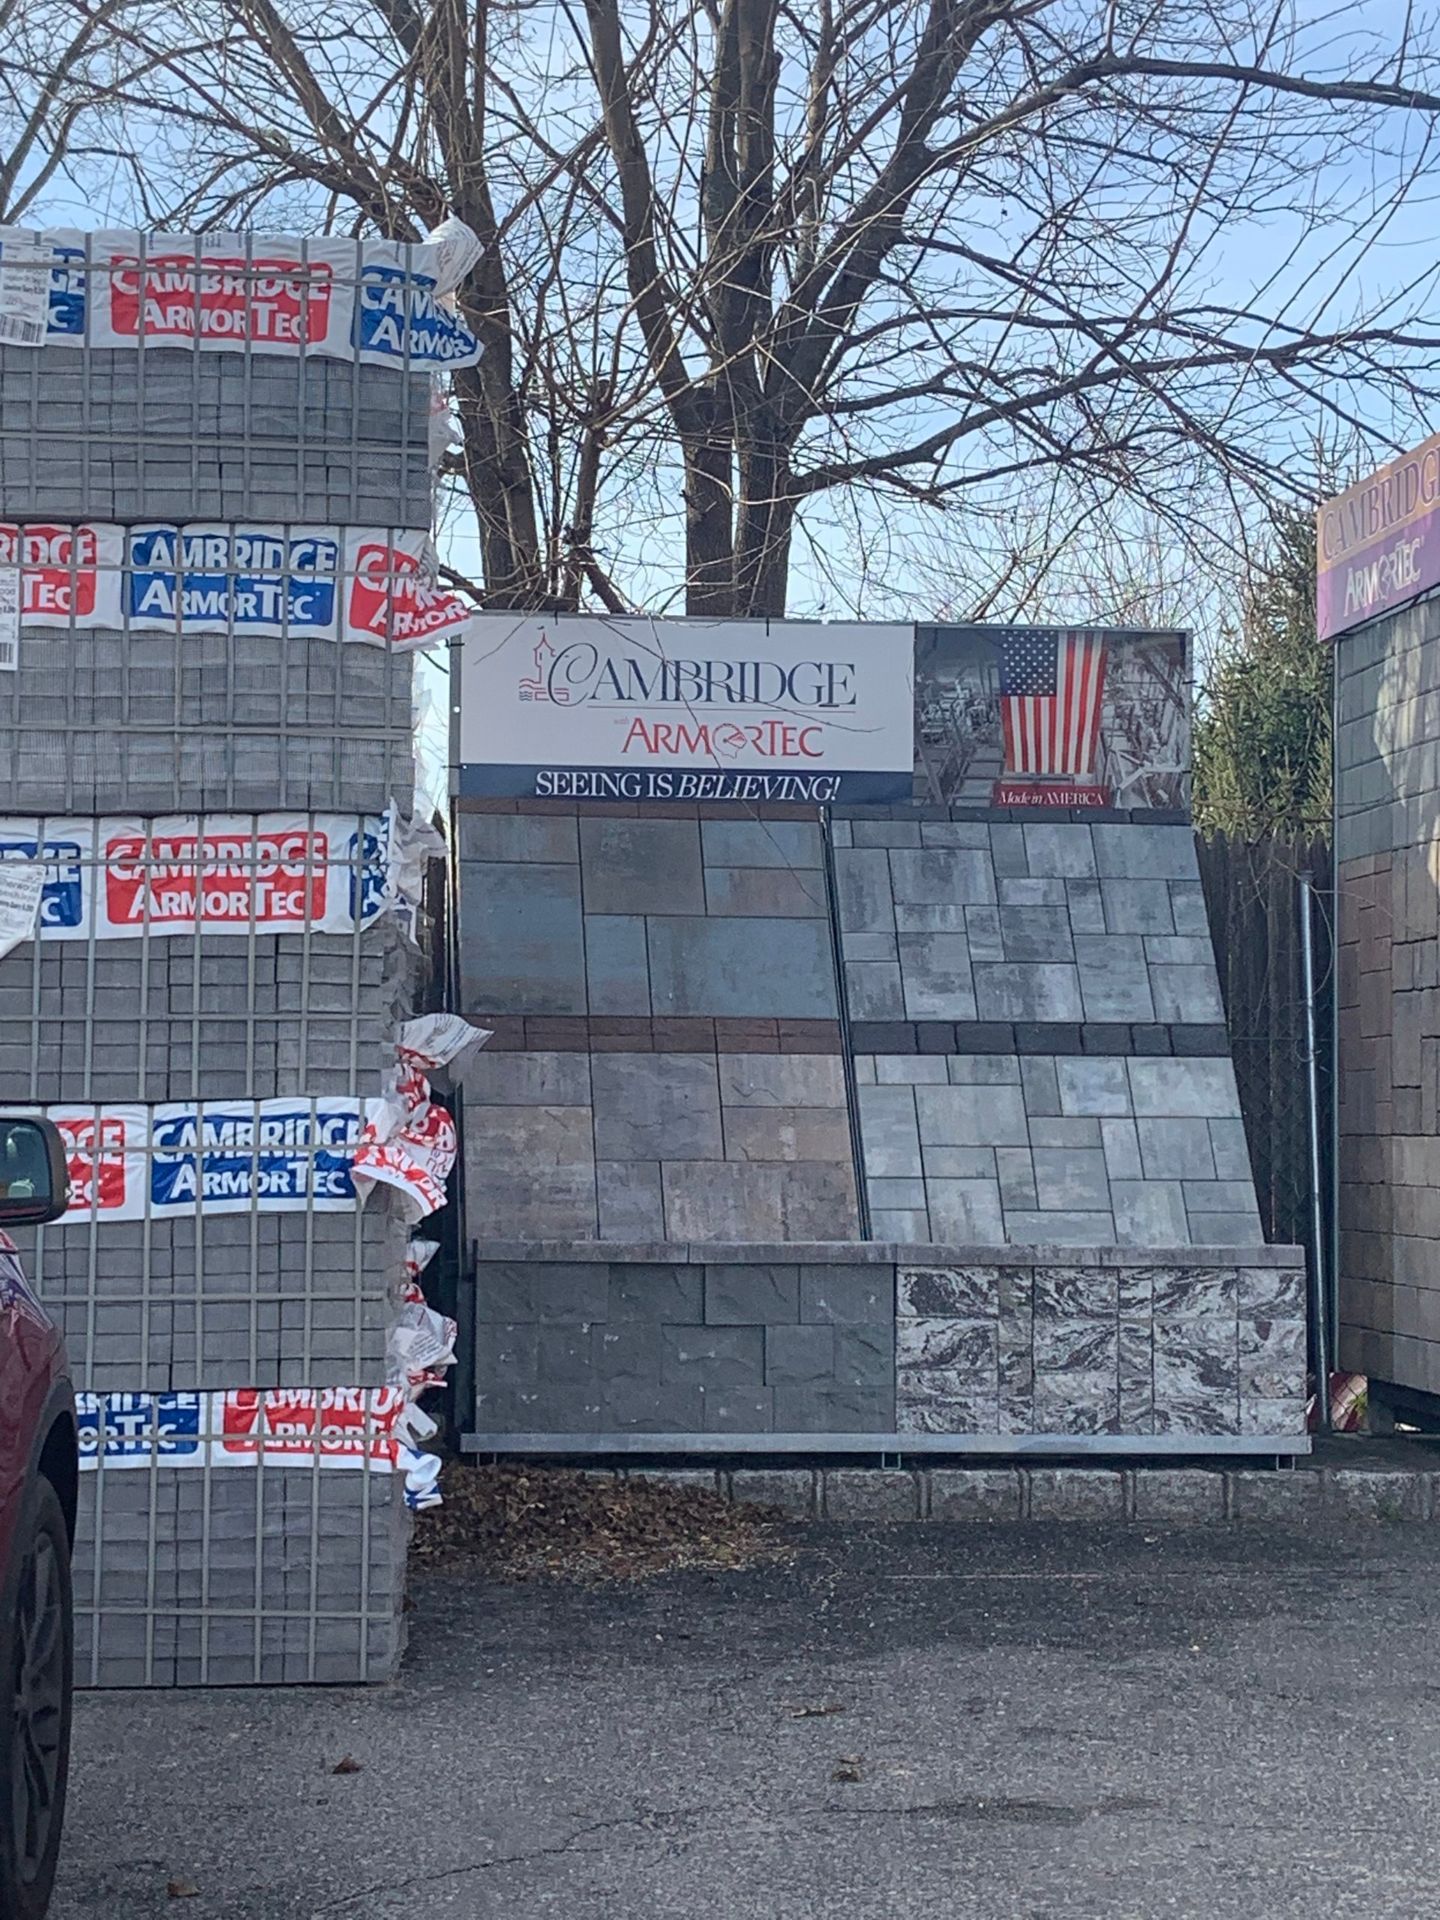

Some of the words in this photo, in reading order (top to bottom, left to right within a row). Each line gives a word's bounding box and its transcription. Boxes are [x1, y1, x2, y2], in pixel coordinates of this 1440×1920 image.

[112, 259, 329, 301] CAMBRIDGE
[1322, 444, 1440, 563] CAMBRIDG
[130, 535, 335, 584] CAMBRIDGE
[548, 643, 857, 707] CAMBRIDGE
[535, 770, 642, 798] SEEING
[646, 772, 673, 798] IS
[675, 774, 841, 801] BELIEVING!
[999, 791, 1030, 805] Made
[1031, 791, 1043, 805] in
[1044, 791, 1104, 805] AMERICA
[108, 837, 325, 880] CAMBRIDGE
